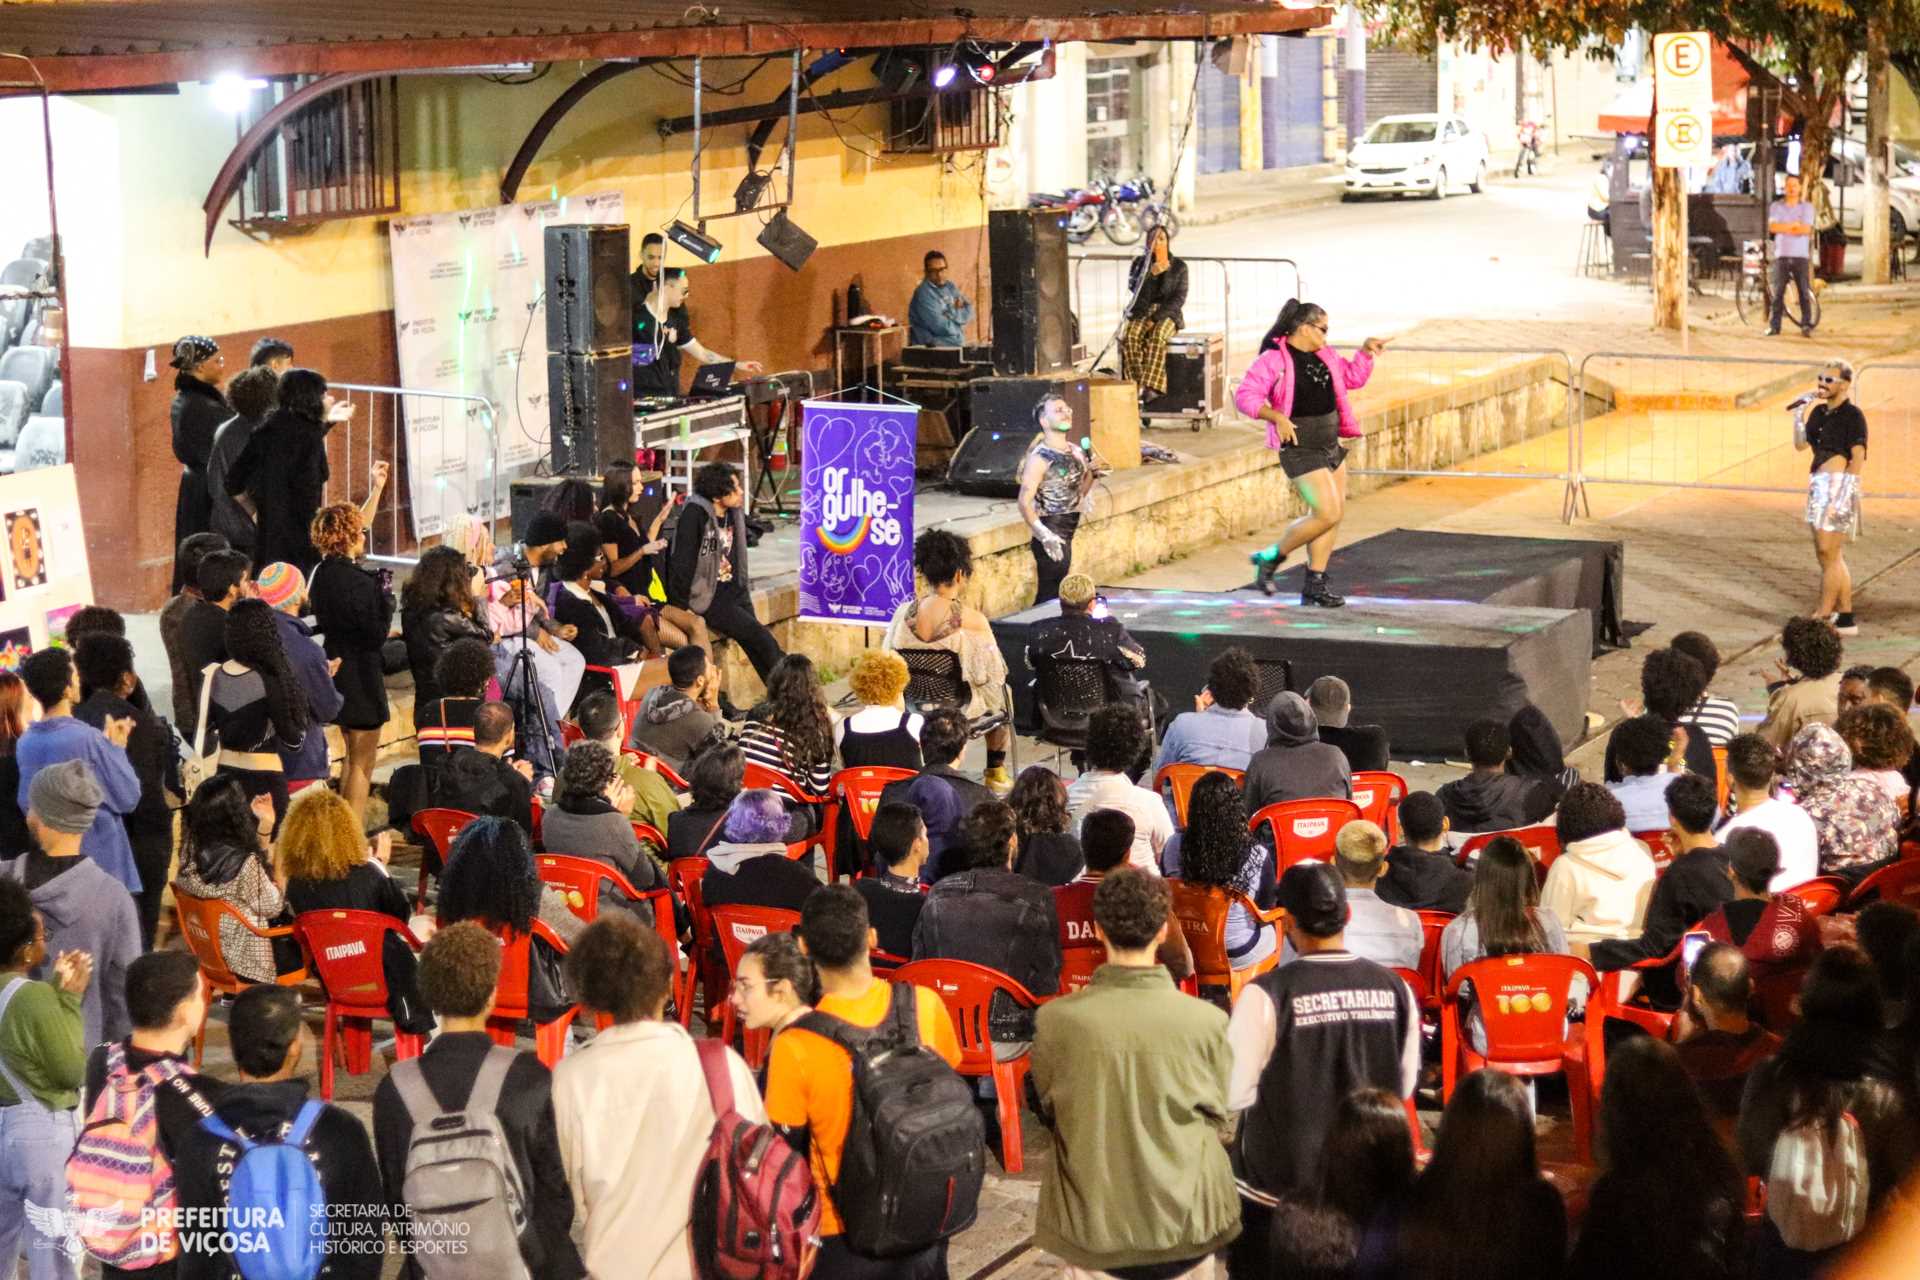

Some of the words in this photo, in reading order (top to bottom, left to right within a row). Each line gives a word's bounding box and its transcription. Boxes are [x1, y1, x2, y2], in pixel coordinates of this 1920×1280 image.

[1675, 44, 1690, 68] E
[823, 467, 849, 494] or
[822, 478, 899, 531] gulhe-
[870, 518, 901, 546] se
[325, 940, 367, 961] ITAIPAVA
[1293, 990, 1395, 1014] SECRETARIADO
[1295, 1011, 1349, 1026] EXECUTIVO
